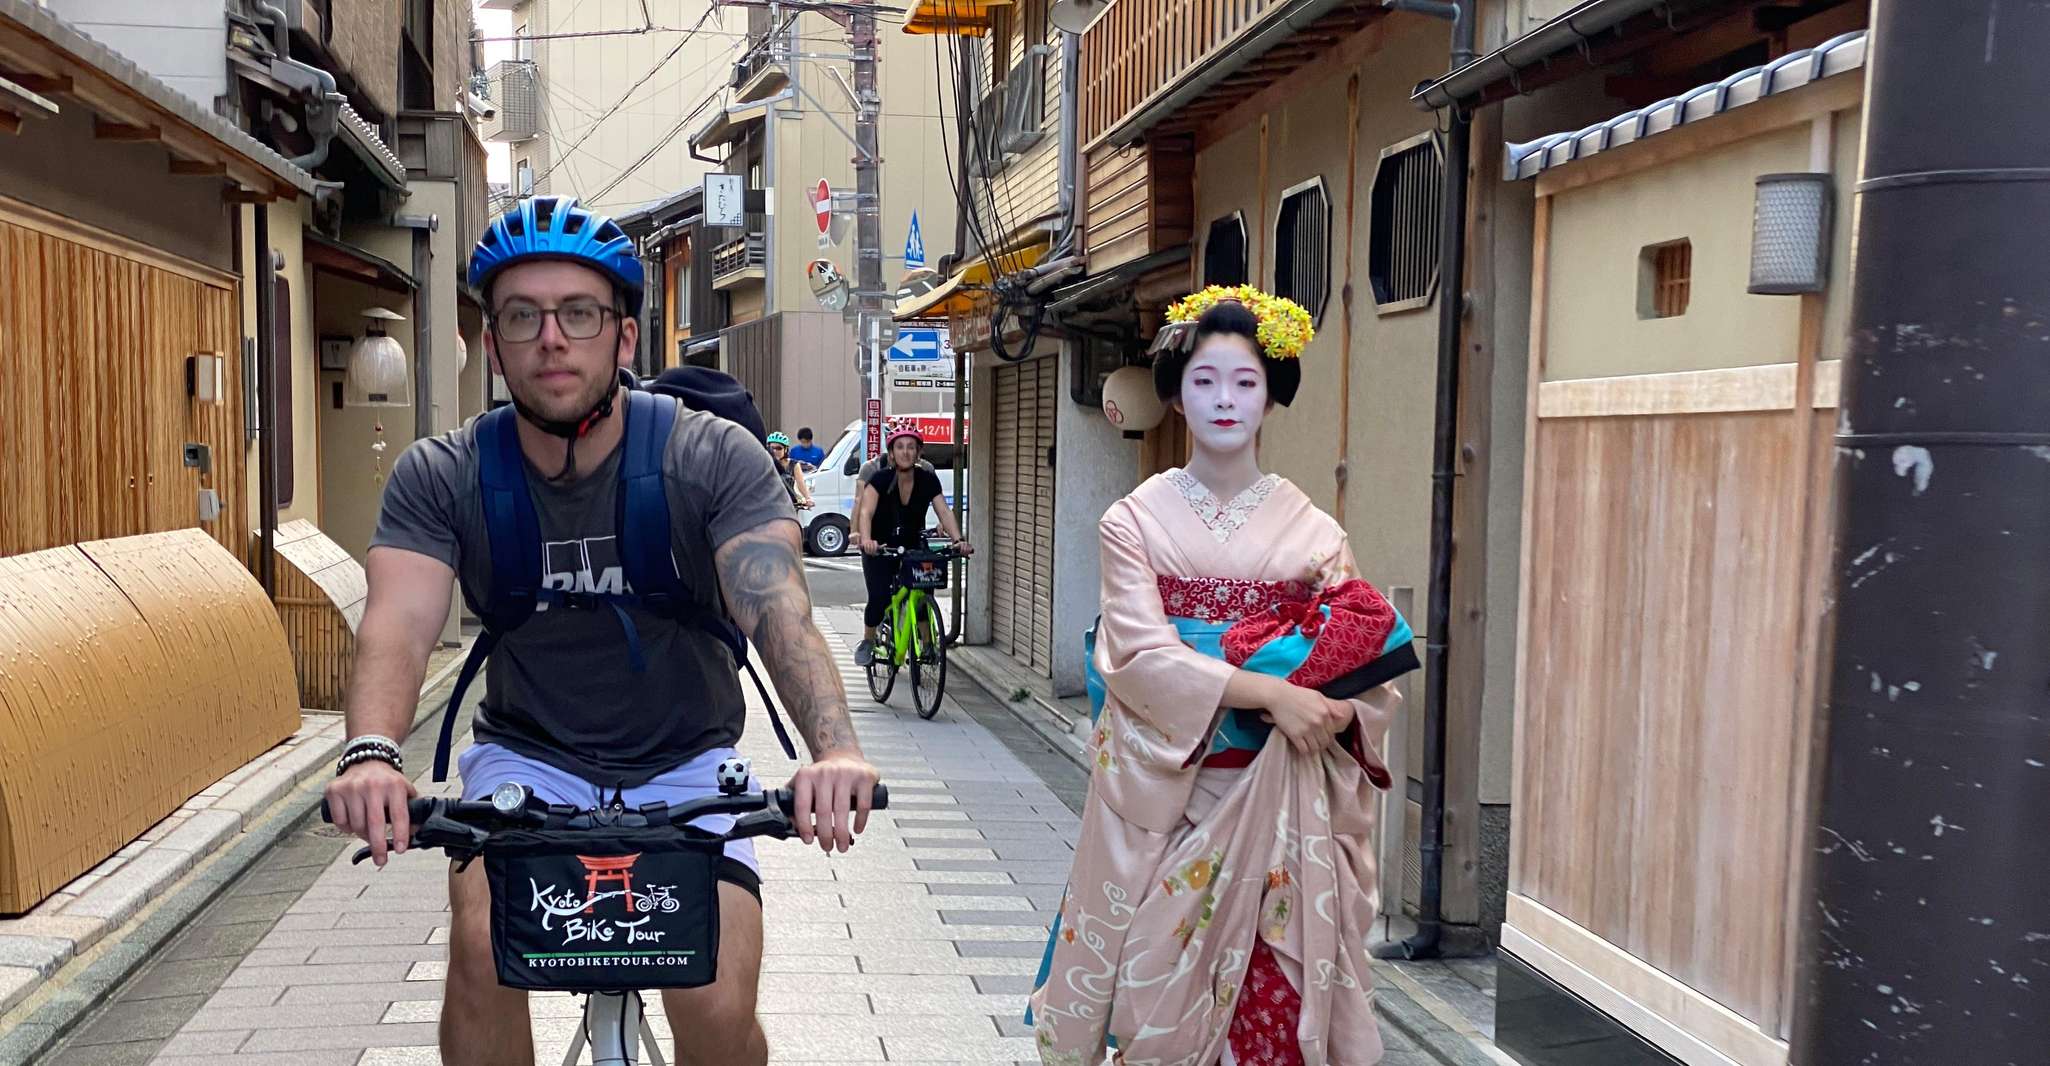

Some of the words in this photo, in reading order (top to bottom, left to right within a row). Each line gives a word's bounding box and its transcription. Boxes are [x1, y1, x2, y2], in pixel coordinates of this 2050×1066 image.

[924, 425, 950, 436] 12/11
[529, 877, 581, 931] Kyoto
[615, 915, 666, 945] Tour
[528, 956, 689, 968] KYOTOBIKETOUR.COM
